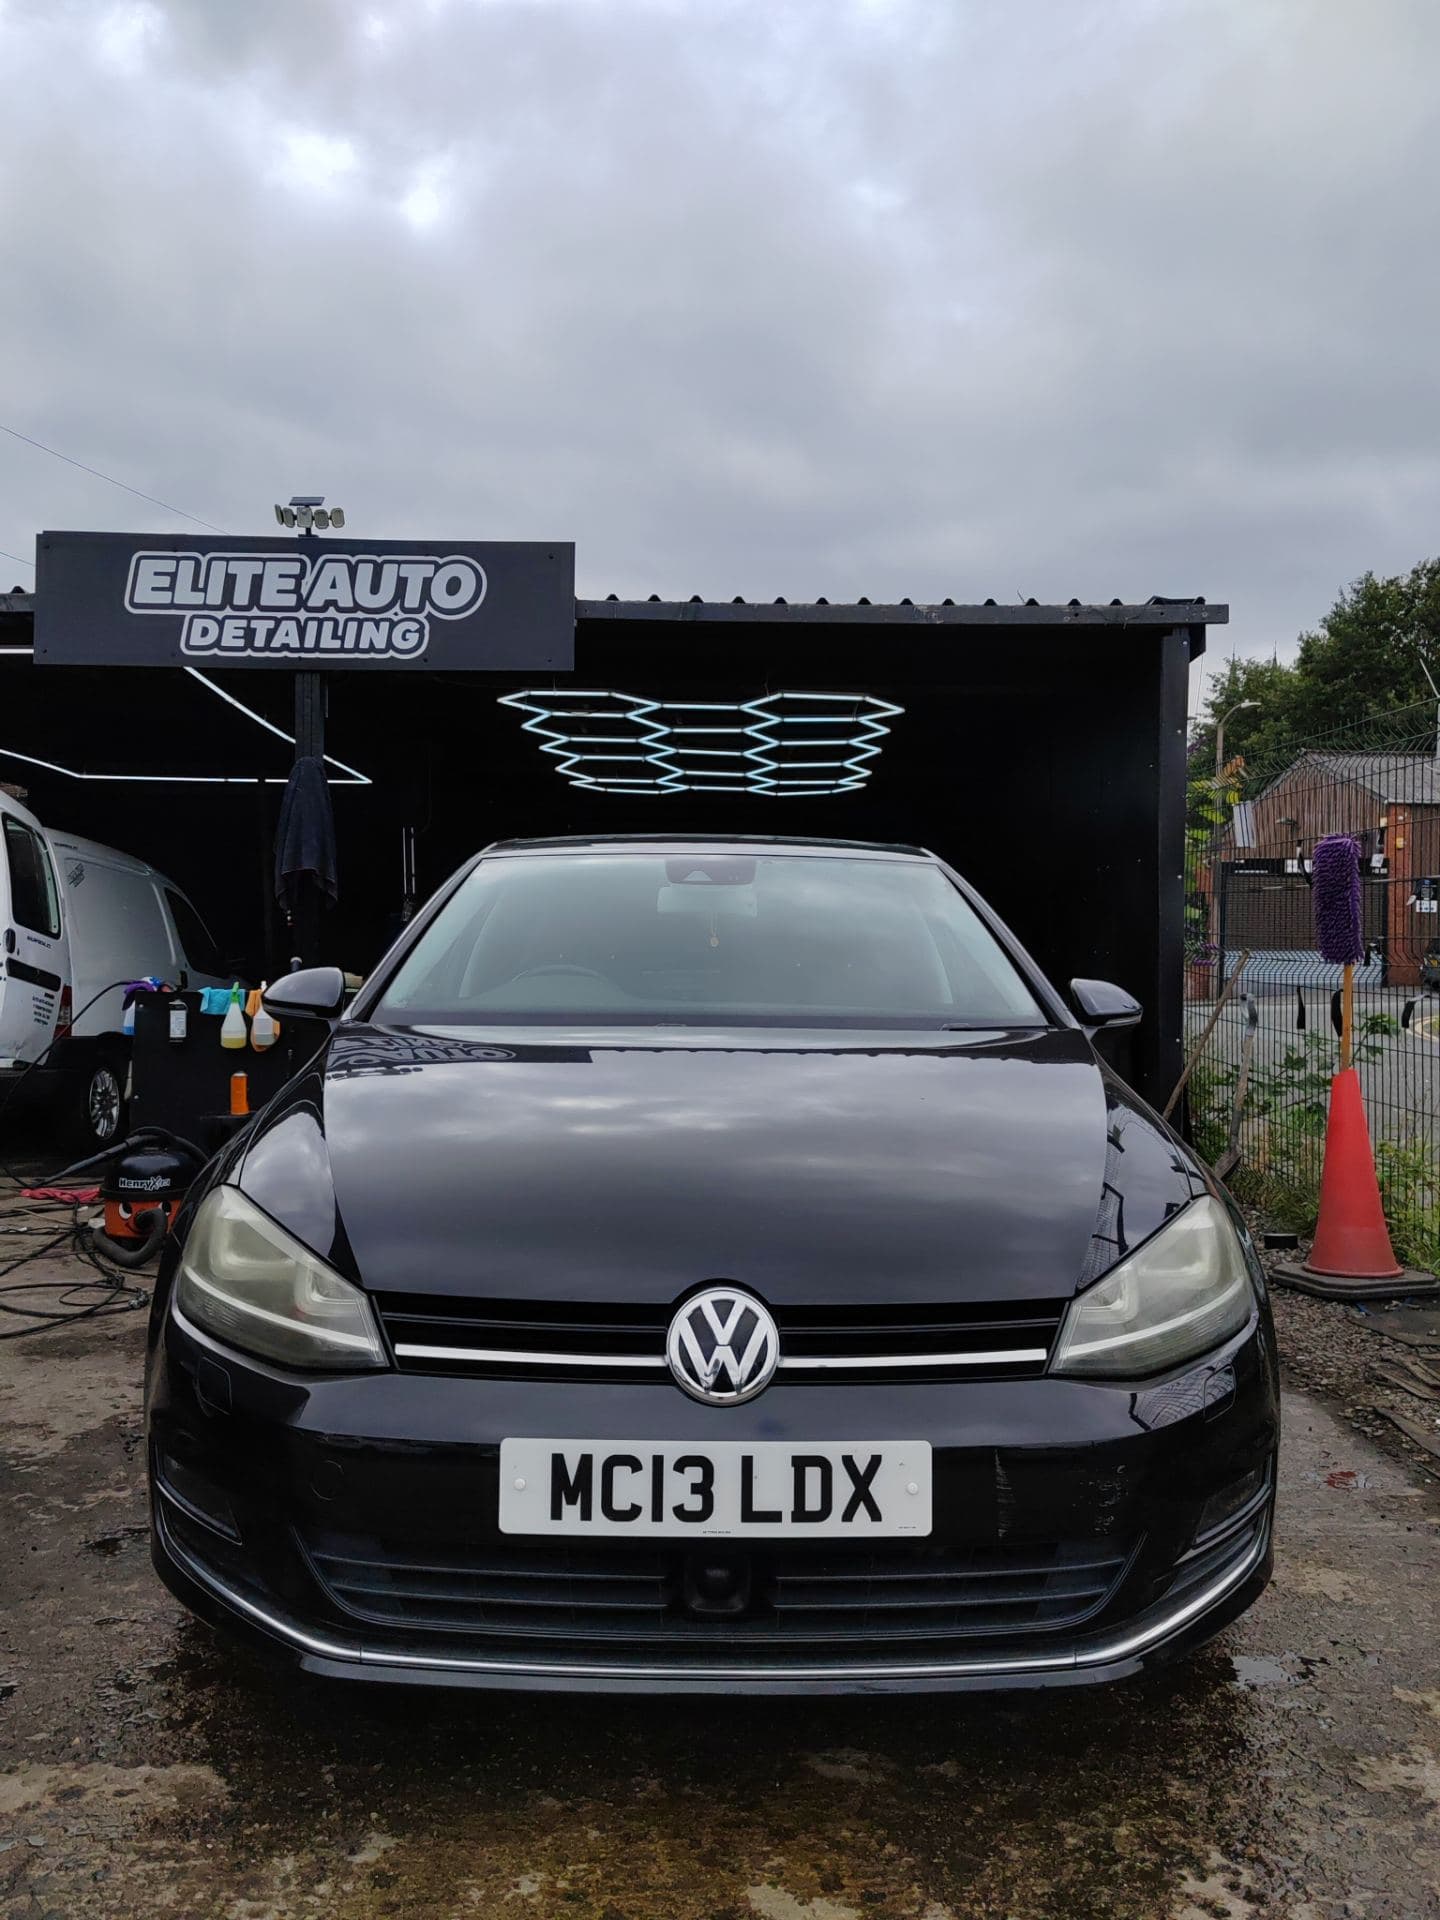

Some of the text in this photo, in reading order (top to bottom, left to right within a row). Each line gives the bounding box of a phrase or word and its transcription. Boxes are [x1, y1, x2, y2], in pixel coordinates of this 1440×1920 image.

[133, 559, 476, 609] ELITE AUTO
[189, 618, 420, 650] DETAILING
[550, 1452, 883, 1523] MC13 LDX
